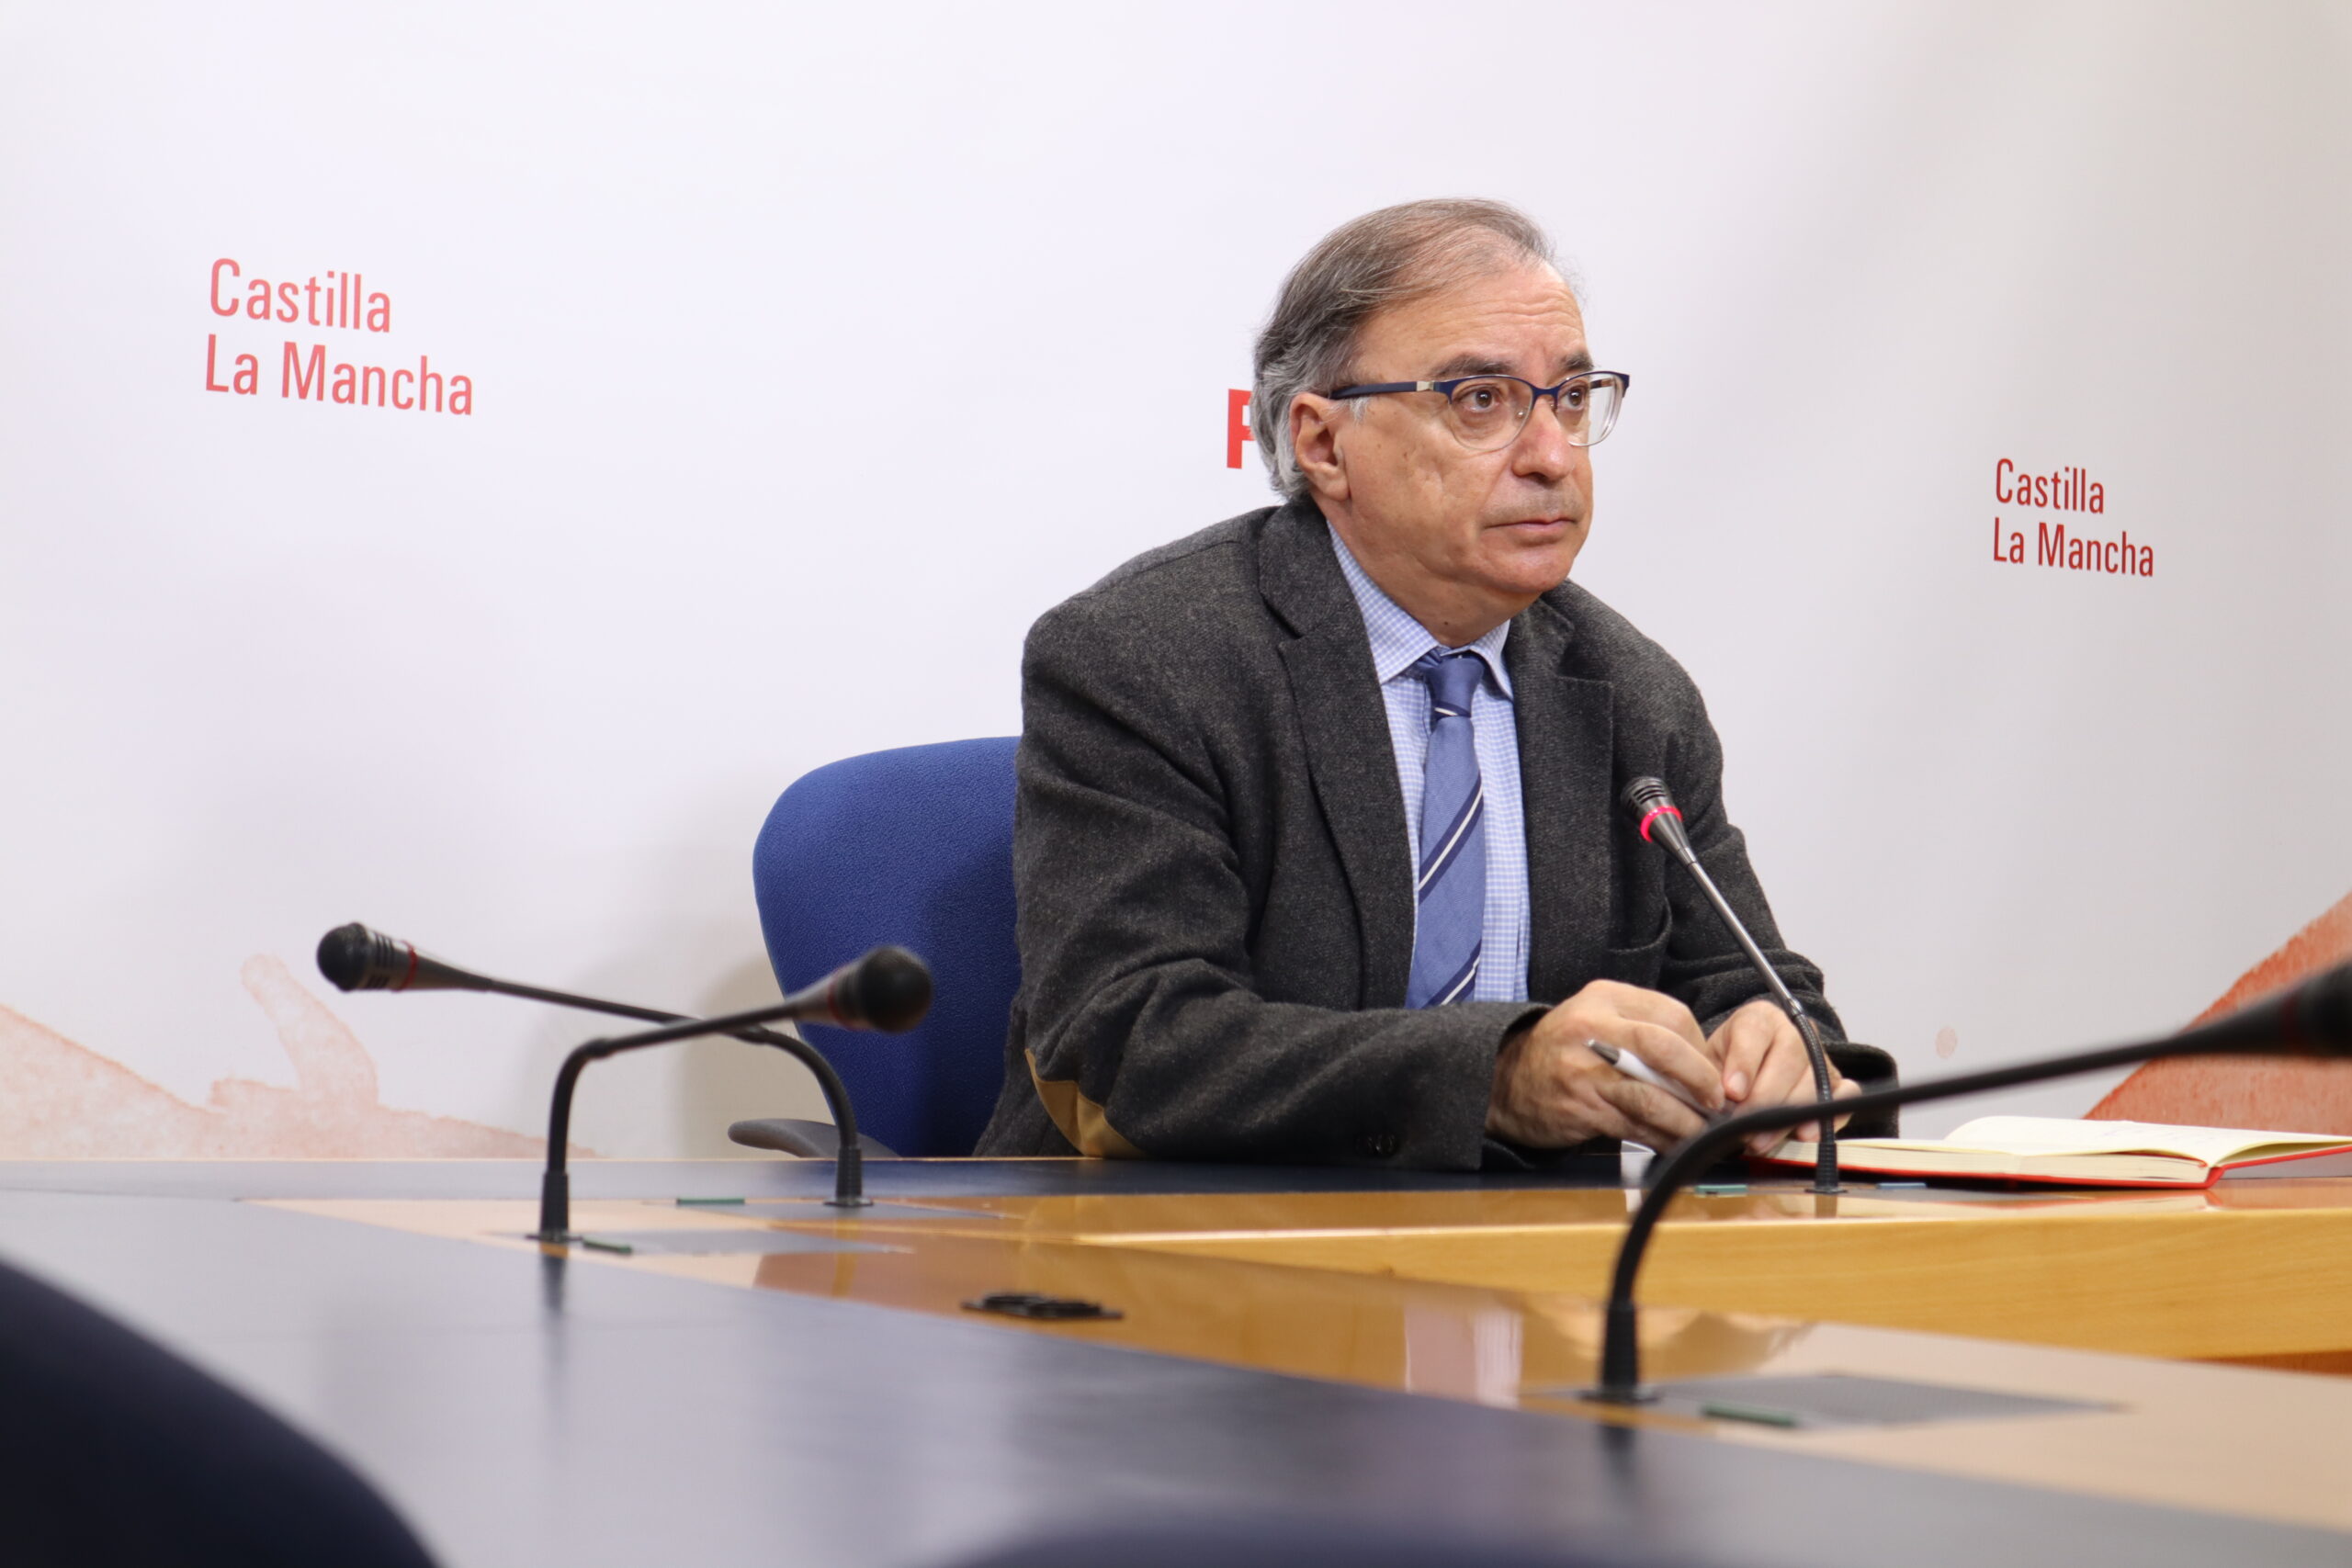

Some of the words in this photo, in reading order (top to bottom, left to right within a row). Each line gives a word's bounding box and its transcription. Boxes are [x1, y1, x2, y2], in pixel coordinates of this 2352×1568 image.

[209, 257, 390, 333] Castilla
[205, 333, 259, 396] La
[281, 341, 472, 416] Mancha
[1996, 457, 2105, 514] Castilla
[1993, 516, 2026, 564] La
[2038, 521, 2154, 577] Mancha
